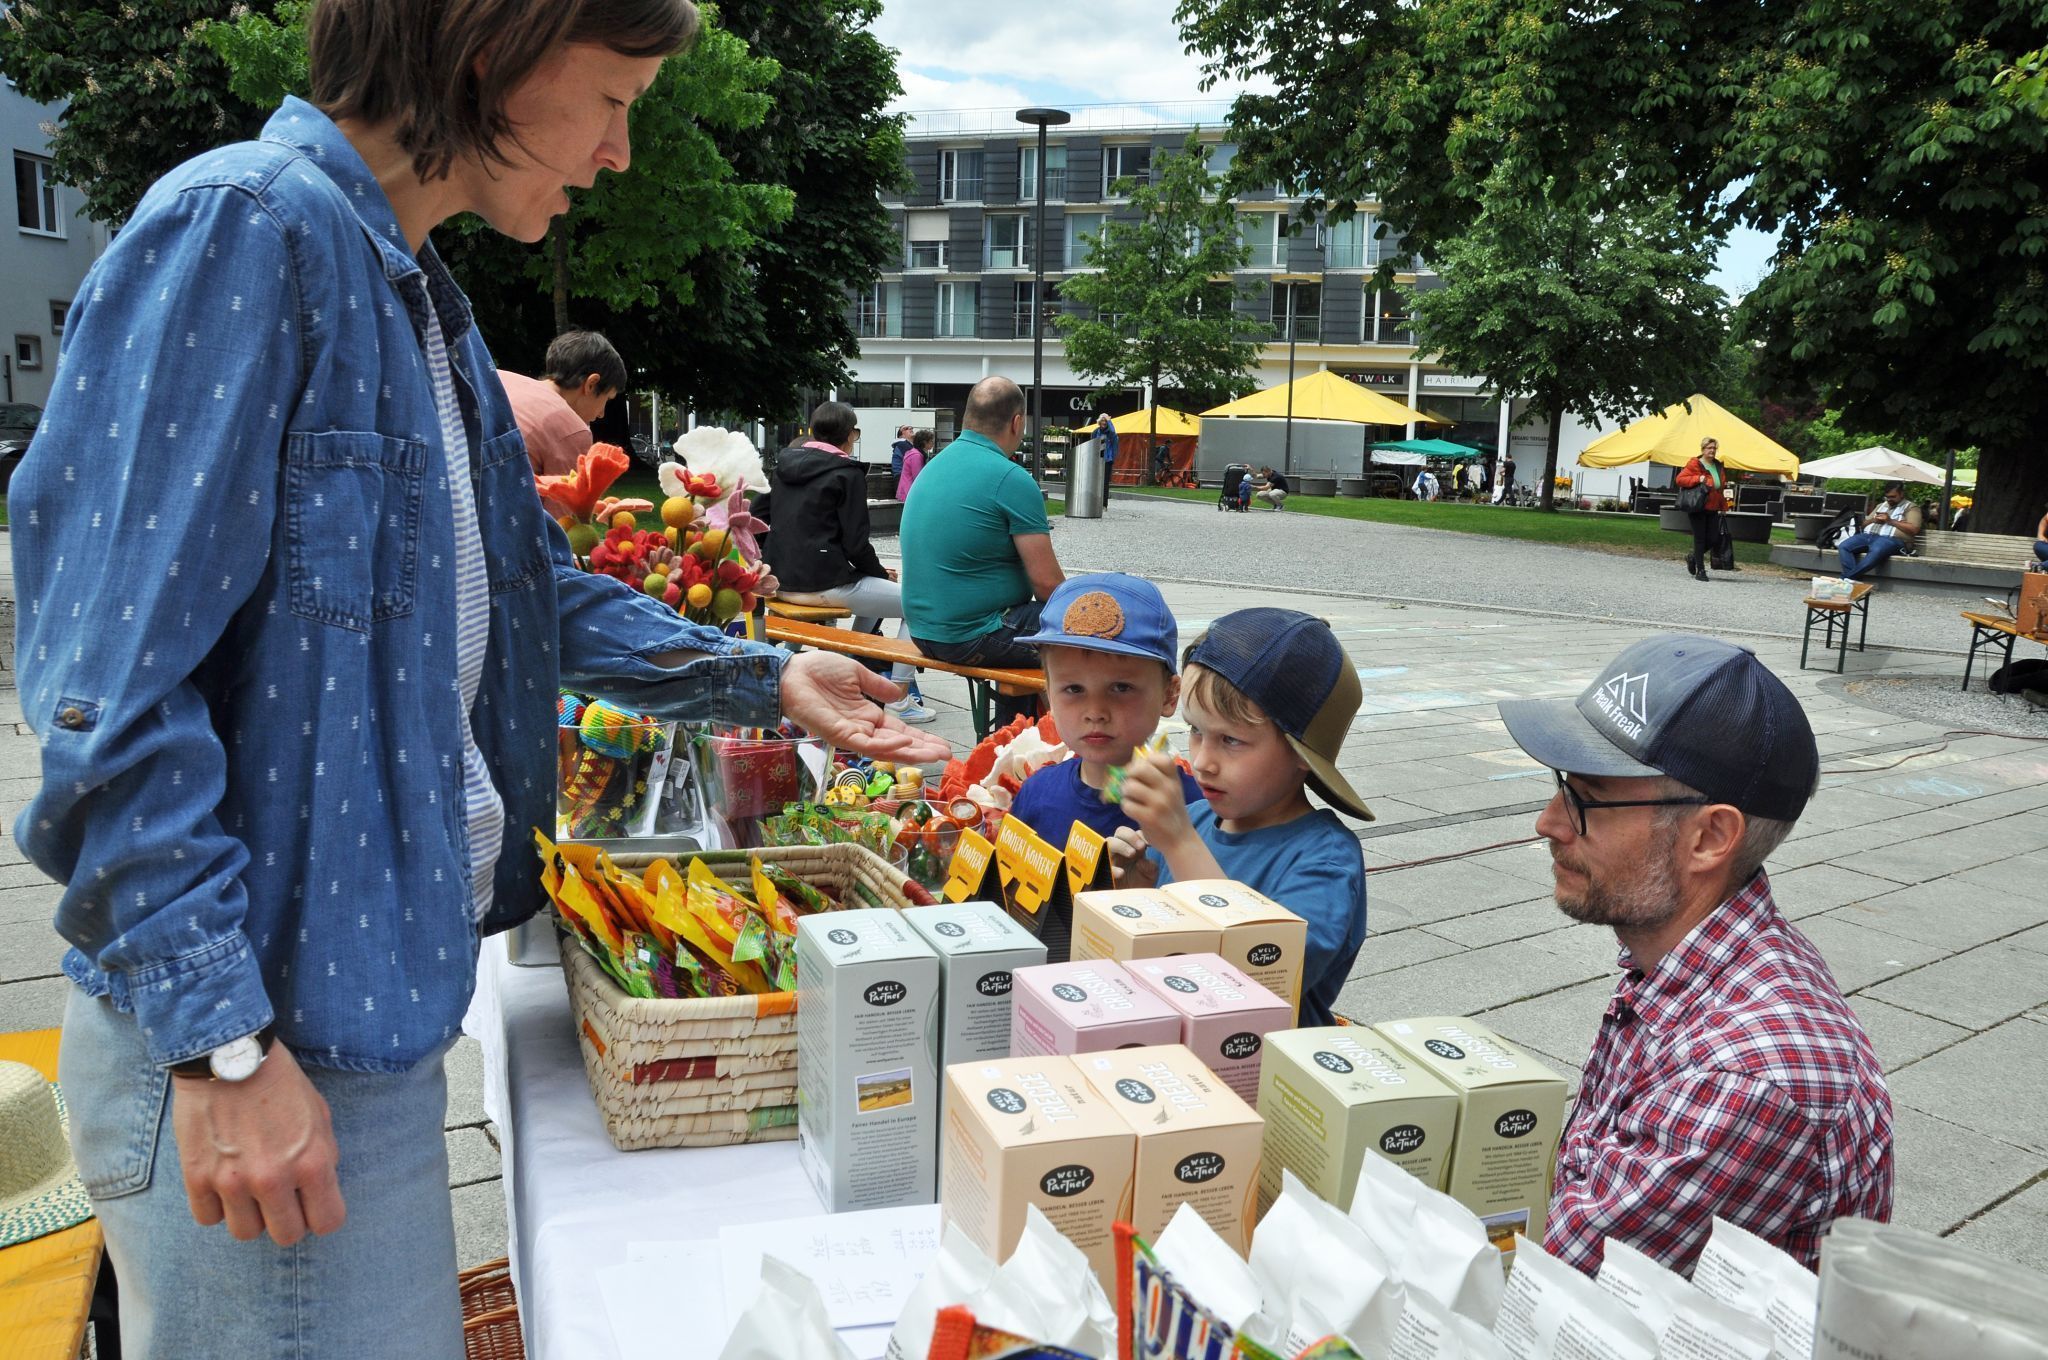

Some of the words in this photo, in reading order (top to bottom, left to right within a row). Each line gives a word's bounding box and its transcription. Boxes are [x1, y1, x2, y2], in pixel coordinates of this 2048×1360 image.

[1343, 374, 1395, 383] CATWALK
[1592, 687, 1614, 714] Peak
[1608, 705, 1643, 740] Freak
[988, 974, 1010, 982] WELT
[1178, 963, 1247, 1001] GRISSINI
[876, 984, 899, 992] WELT
[1071, 969, 1135, 1010] GRISSINI
[868, 990, 904, 1003] Partner
[1233, 1036, 1255, 1044] WELT
[1436, 1025, 1518, 1069] GRISSINI
[1225, 1041, 1259, 1056] Partner
[1327, 1037, 1407, 1085] GRISSINI
[1138, 1062, 1208, 1112] TRECCE
[1187, 1073, 1212, 1093] natur
[1016, 1072, 1079, 1123] TRECCE
[1064, 1084, 1086, 1104] natur
[1508, 1113, 1531, 1122] WELT
[1394, 1128, 1418, 1138] WELT
[1500, 1120, 1535, 1135] Partner
[1385, 1135, 1423, 1151] Partner
[1190, 1156, 1217, 1166] WELT
[1057, 1168, 1085, 1179] WELT
[1180, 1163, 1222, 1180] Partner
[1046, 1176, 1090, 1193] Partner
